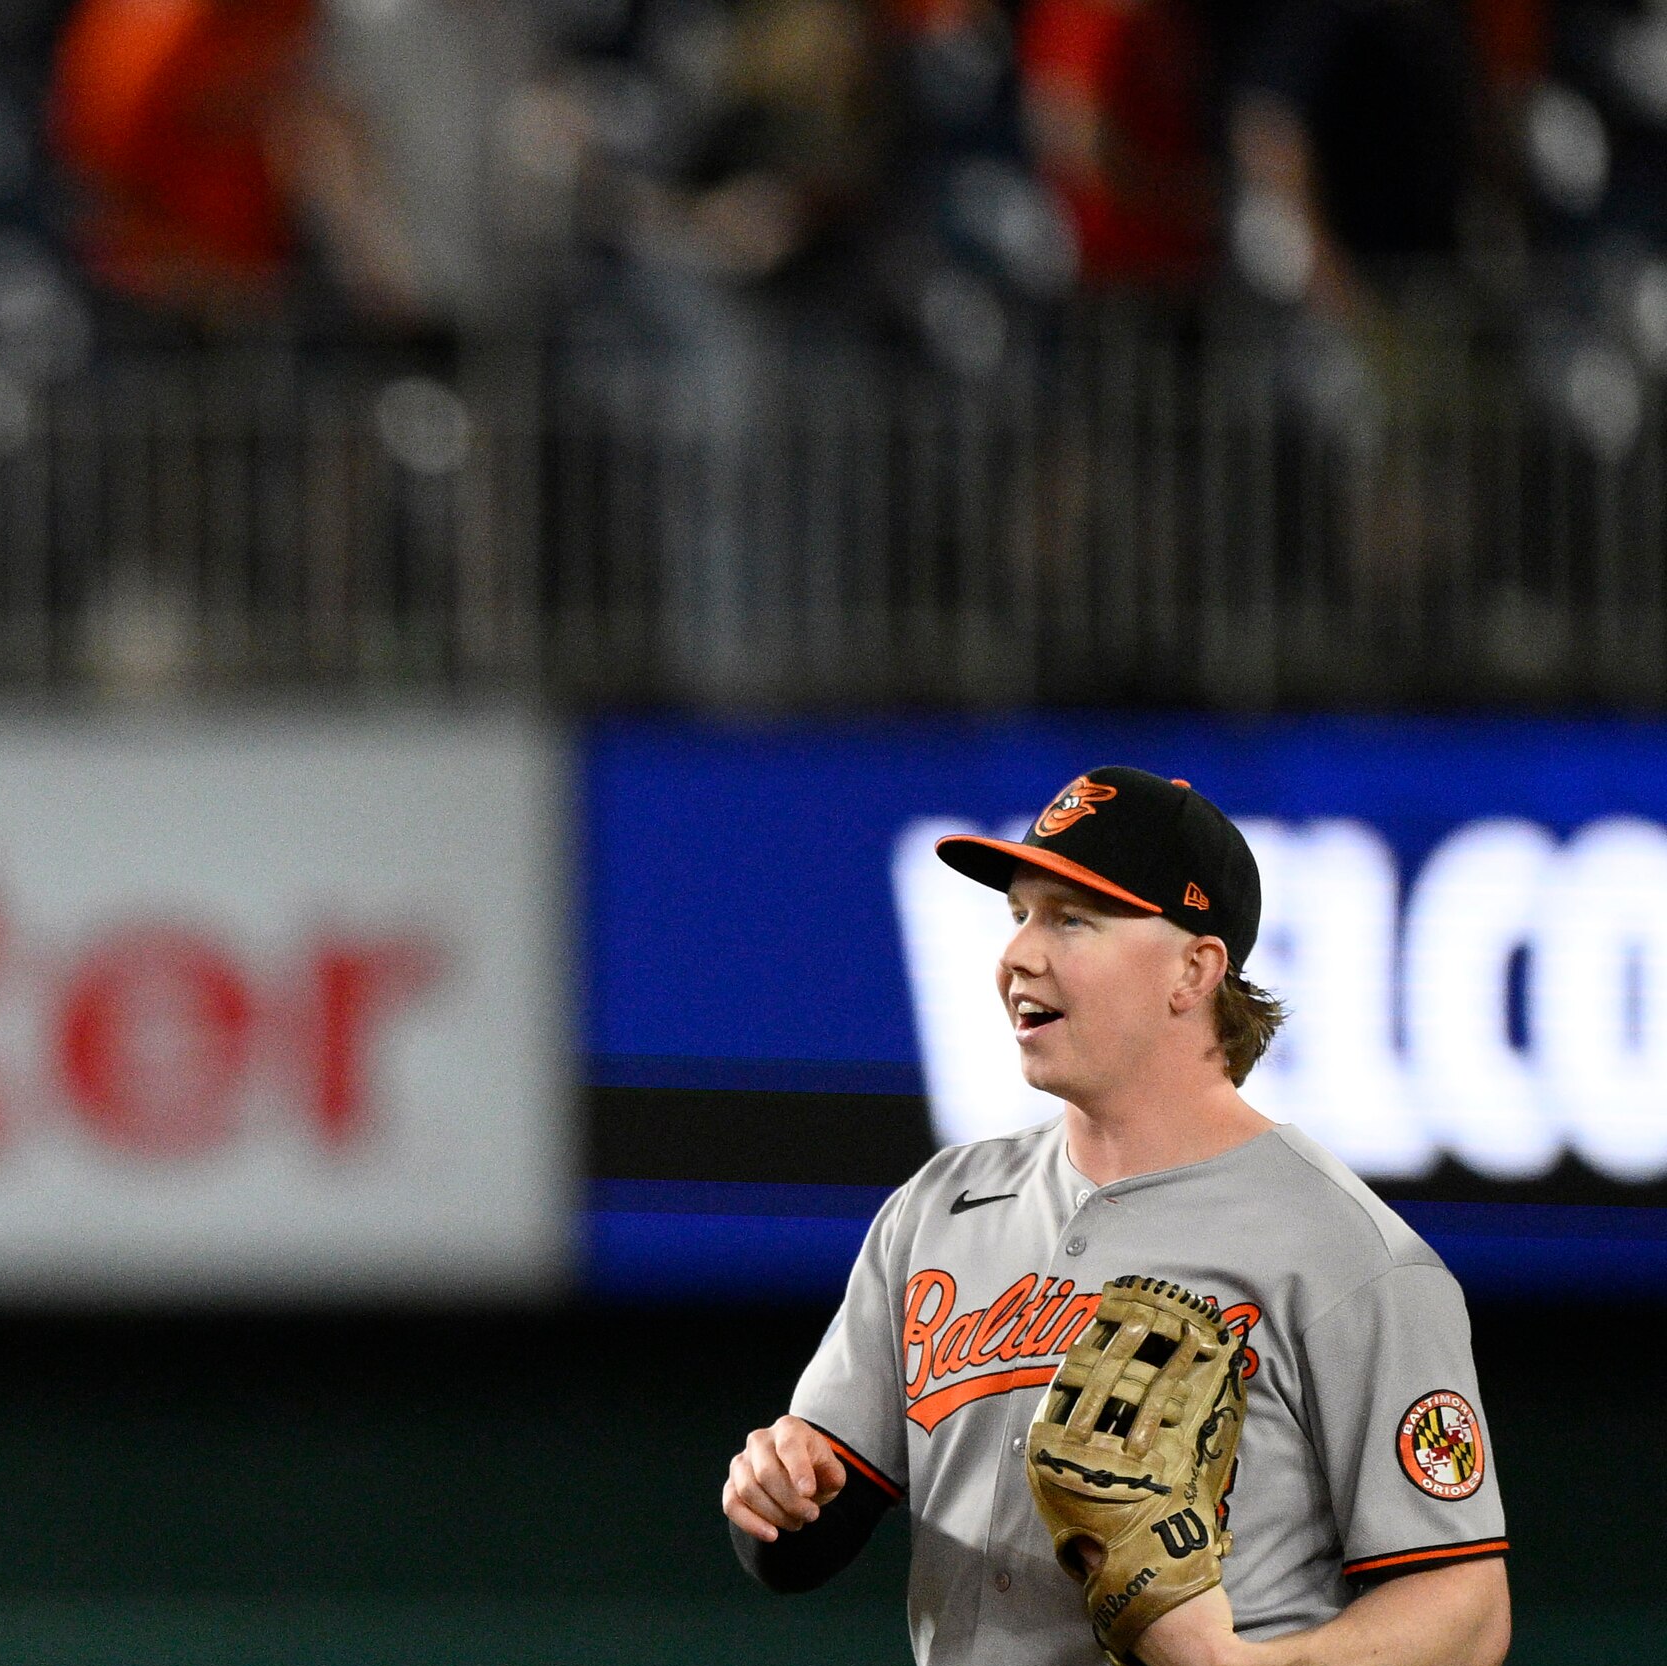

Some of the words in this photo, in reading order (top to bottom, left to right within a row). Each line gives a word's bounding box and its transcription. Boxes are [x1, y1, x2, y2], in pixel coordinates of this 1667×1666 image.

[1403, 1394, 1475, 1435] BALTIMORE
[1422, 1470, 1481, 1496] ORIOLES
[1150, 1507, 1208, 1560] W
